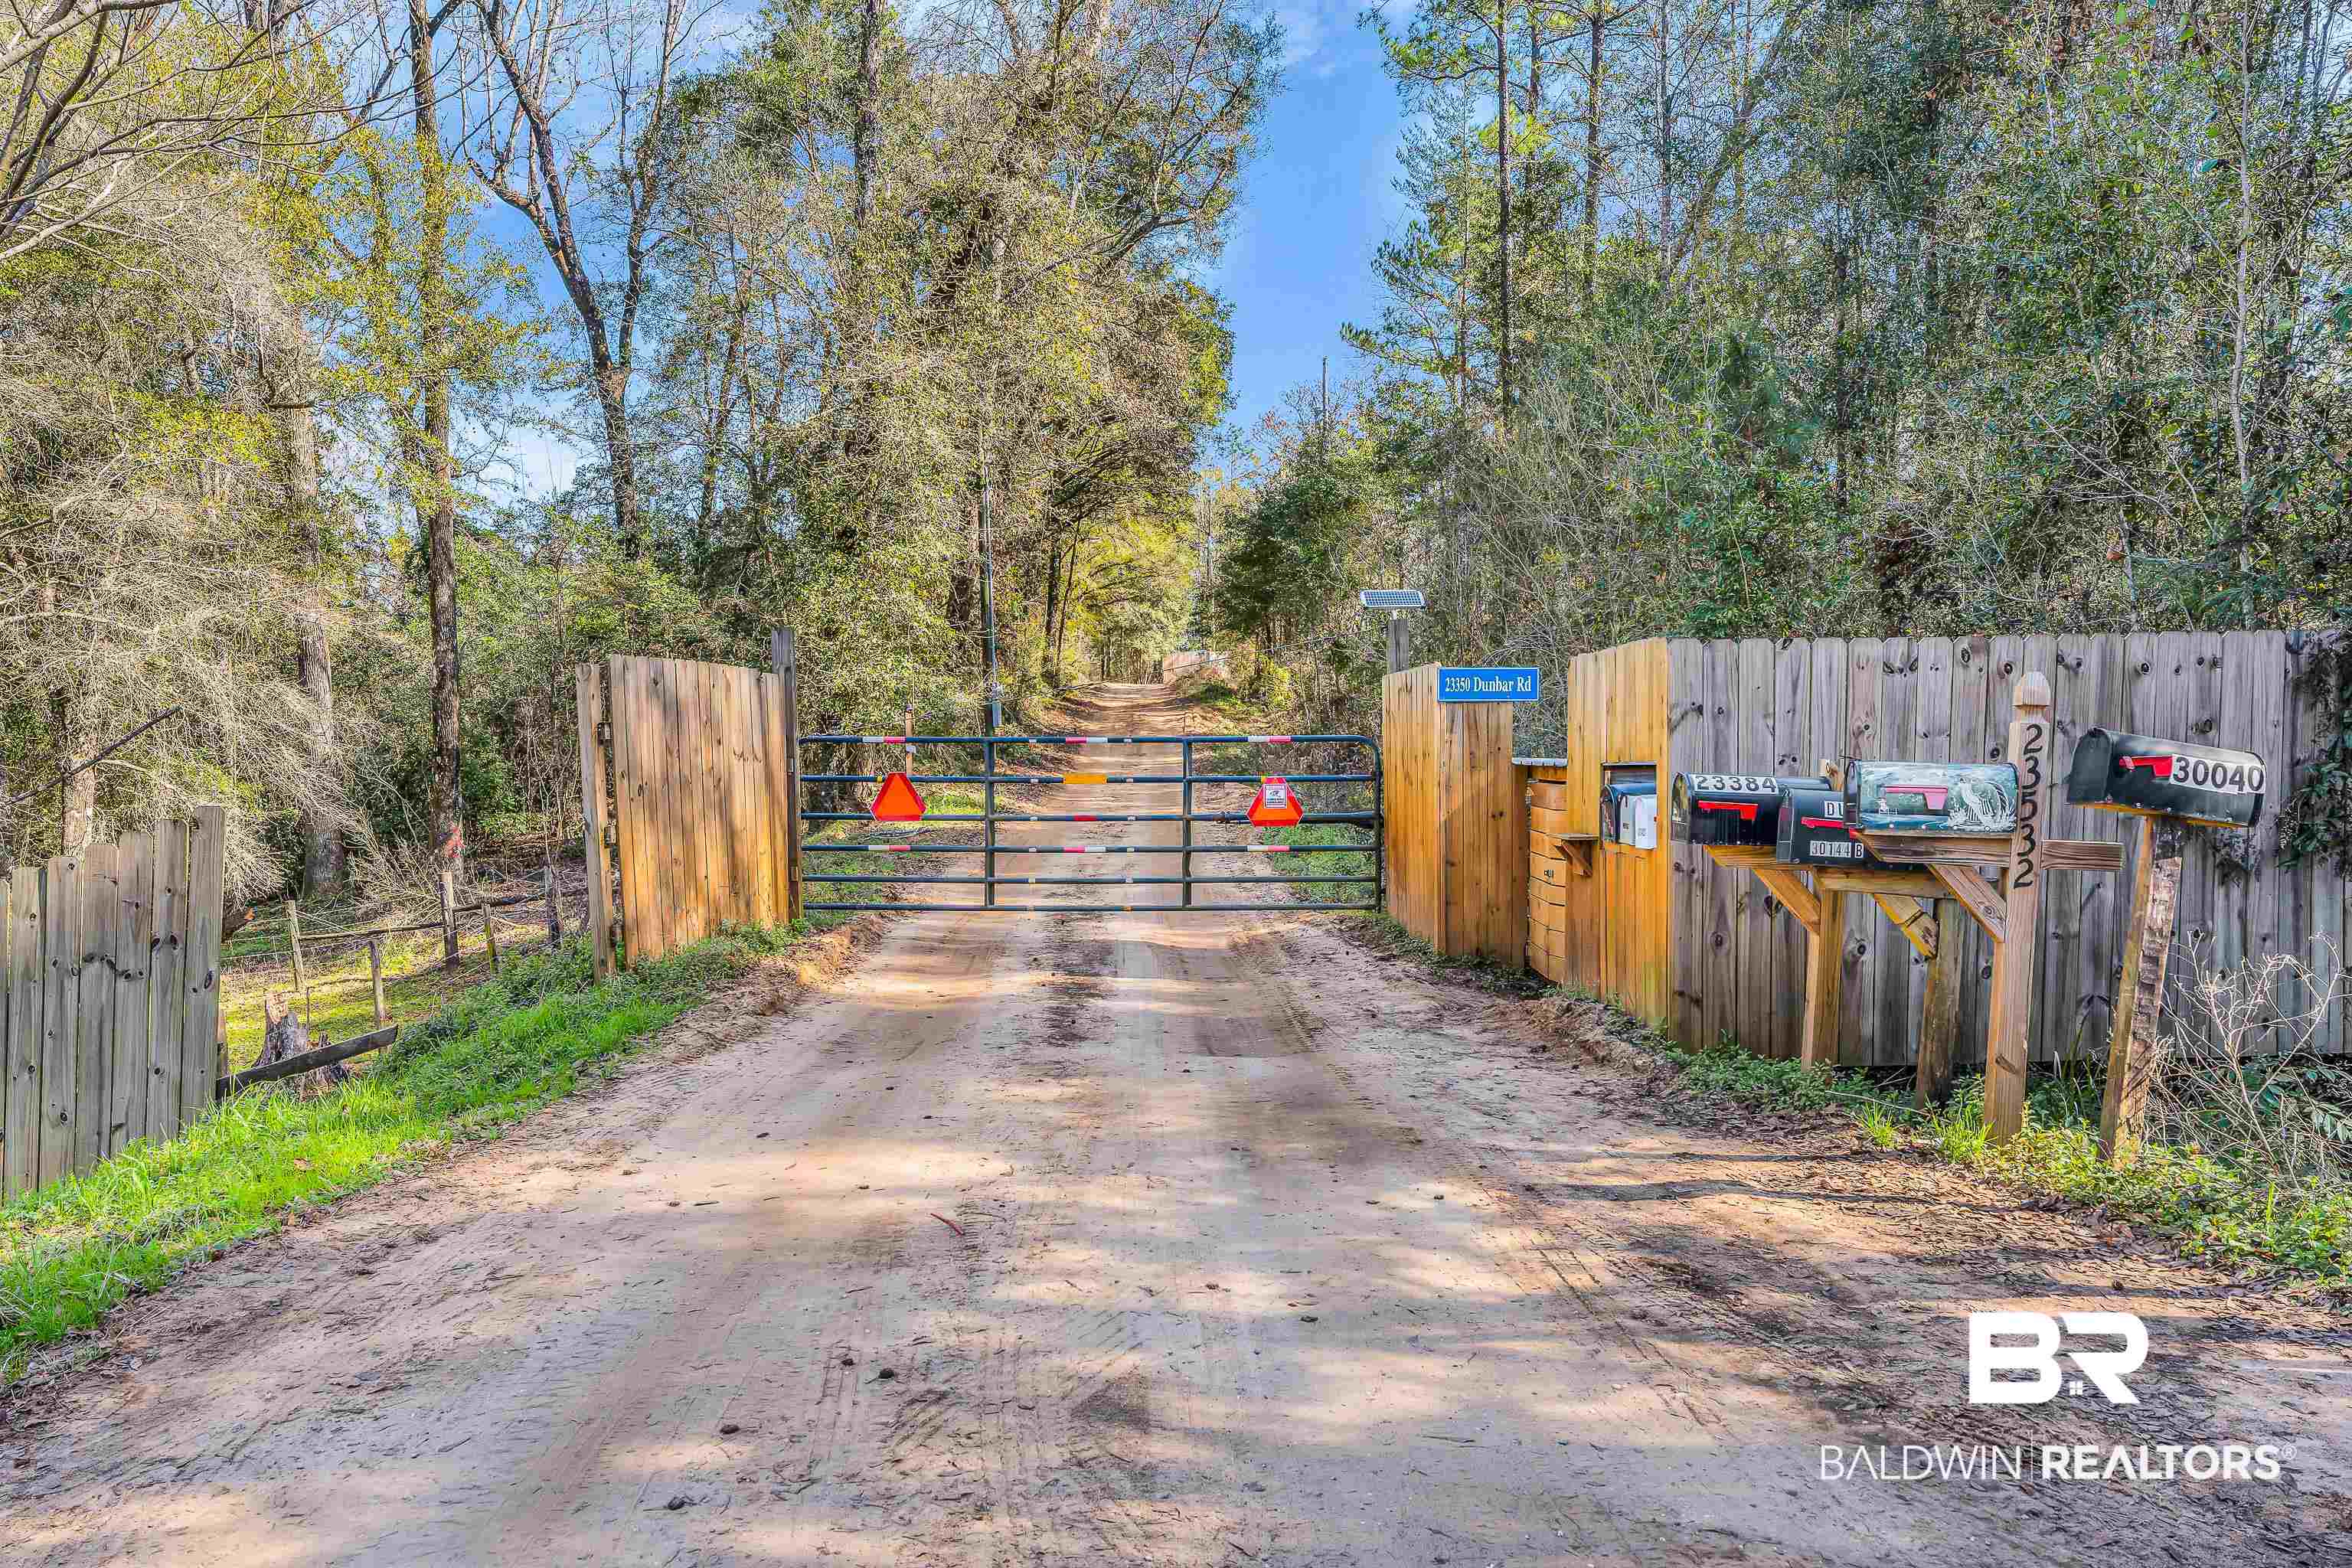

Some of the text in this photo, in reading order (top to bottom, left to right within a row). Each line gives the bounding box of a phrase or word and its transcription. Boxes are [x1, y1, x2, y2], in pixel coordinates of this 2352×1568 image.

[1445, 675, 1532, 692] 23350 Dunbar Rd
[1695, 776, 1776, 792] 23384
[2173, 756, 2265, 792] 30040
[2013, 724, 2043, 890] 23532
